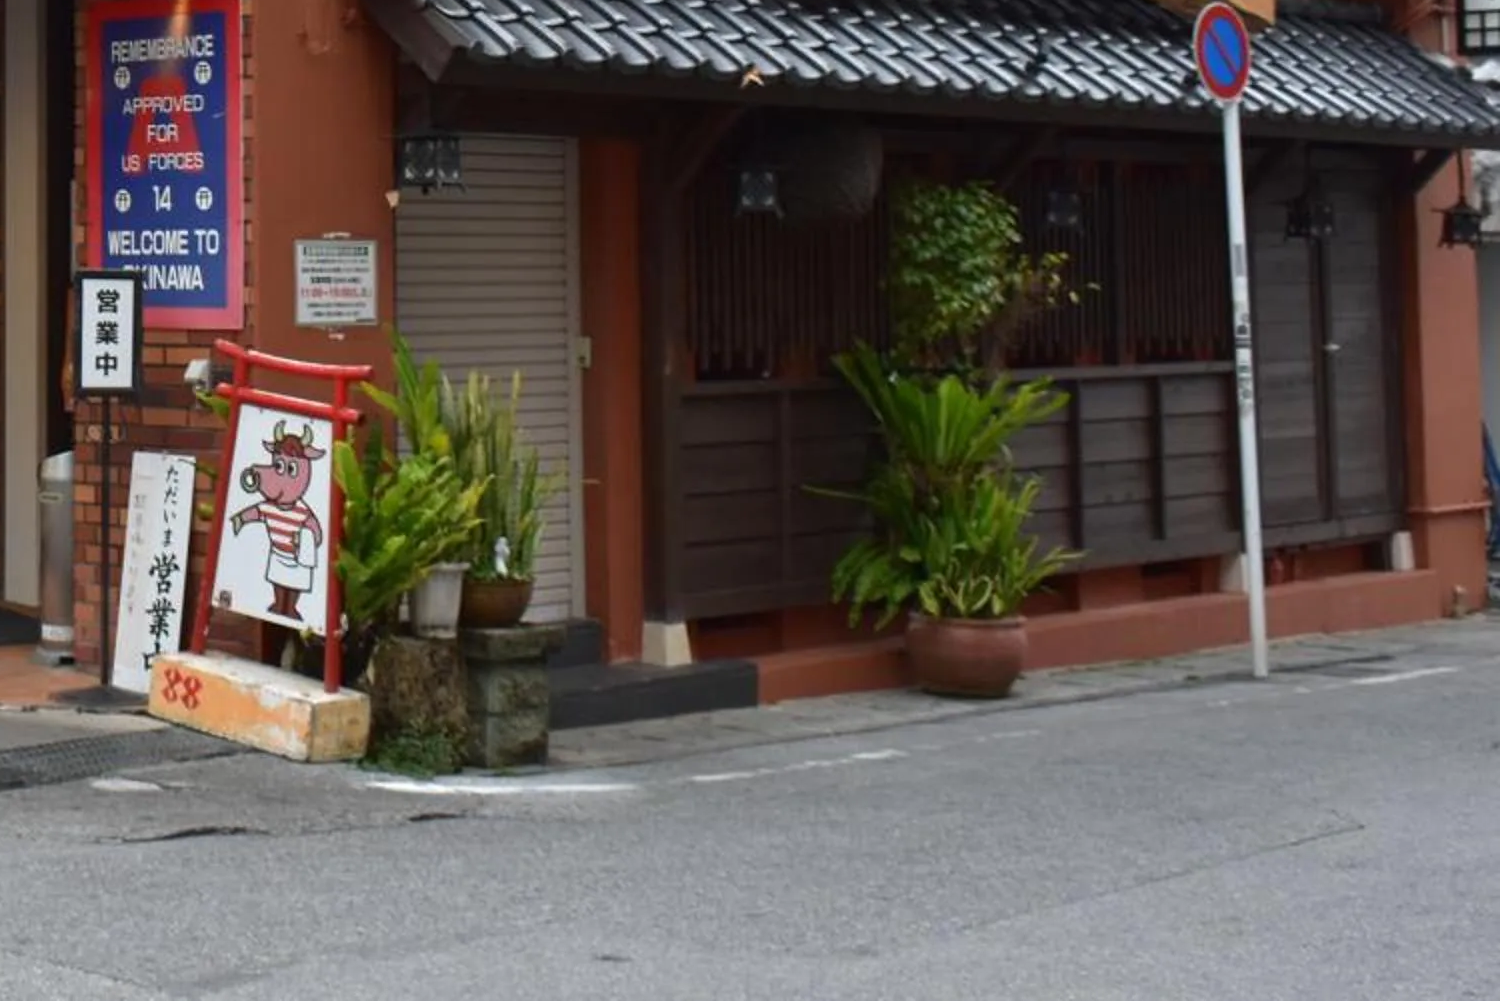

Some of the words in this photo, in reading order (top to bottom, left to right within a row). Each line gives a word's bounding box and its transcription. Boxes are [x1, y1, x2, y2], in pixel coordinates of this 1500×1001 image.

[111, 34, 214, 63] REMEMBRANCE
[123, 95, 204, 115] APPROVED
[147, 124, 178, 143] FOR
[121, 154, 141, 172] US
[148, 152, 204, 171] FORCES
[152, 184, 172, 212] 14
[108, 230, 189, 255] WELCOME
[194, 229, 219, 255] TO
[123, 264, 205, 291] KINAWA
[95, 288, 120, 377] 営業中
[161, 668, 203, 711] 88
